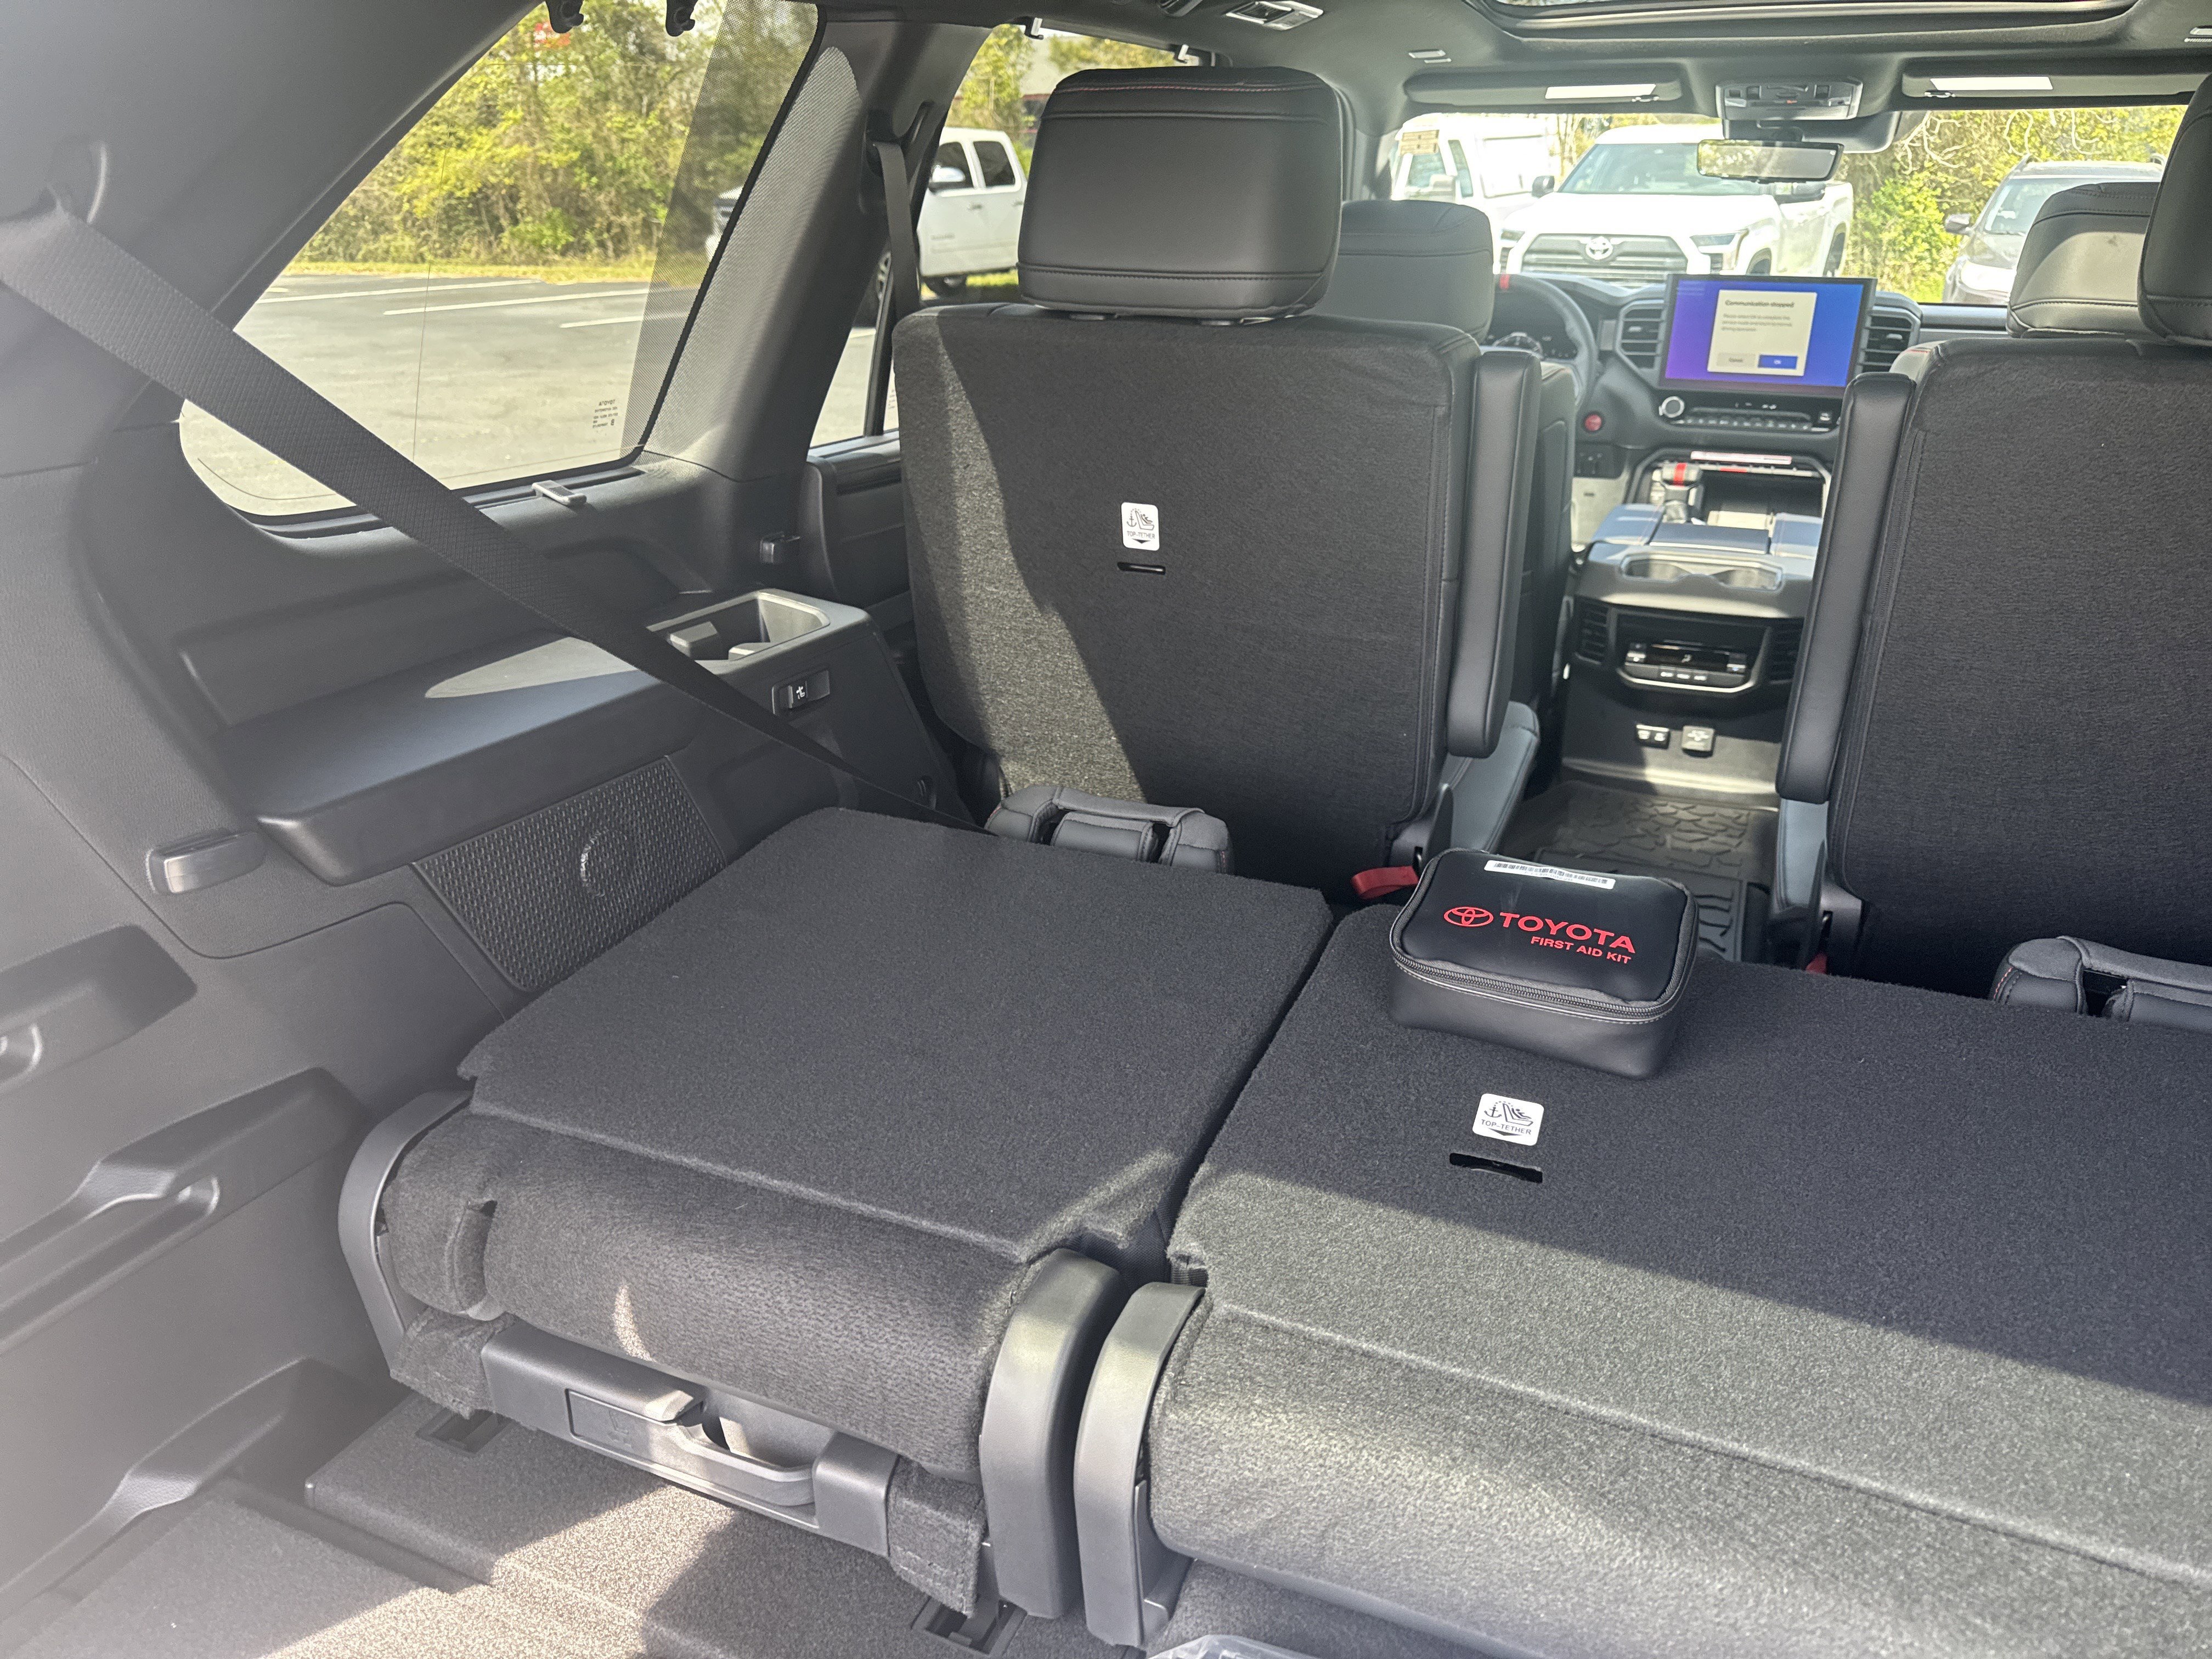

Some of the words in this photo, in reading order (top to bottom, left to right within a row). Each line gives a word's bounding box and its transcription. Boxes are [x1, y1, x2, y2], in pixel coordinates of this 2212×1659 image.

[1126, 531, 1155, 539] TOP-TETHER
[1499, 912, 1635, 953] TOYOTA
[1531, 936, 1574, 950] FIRST
[1576, 945, 1603, 957] AID
[1606, 951, 1632, 964] KIT
[1481, 1119, 1532, 1135] TOP-TETHER
